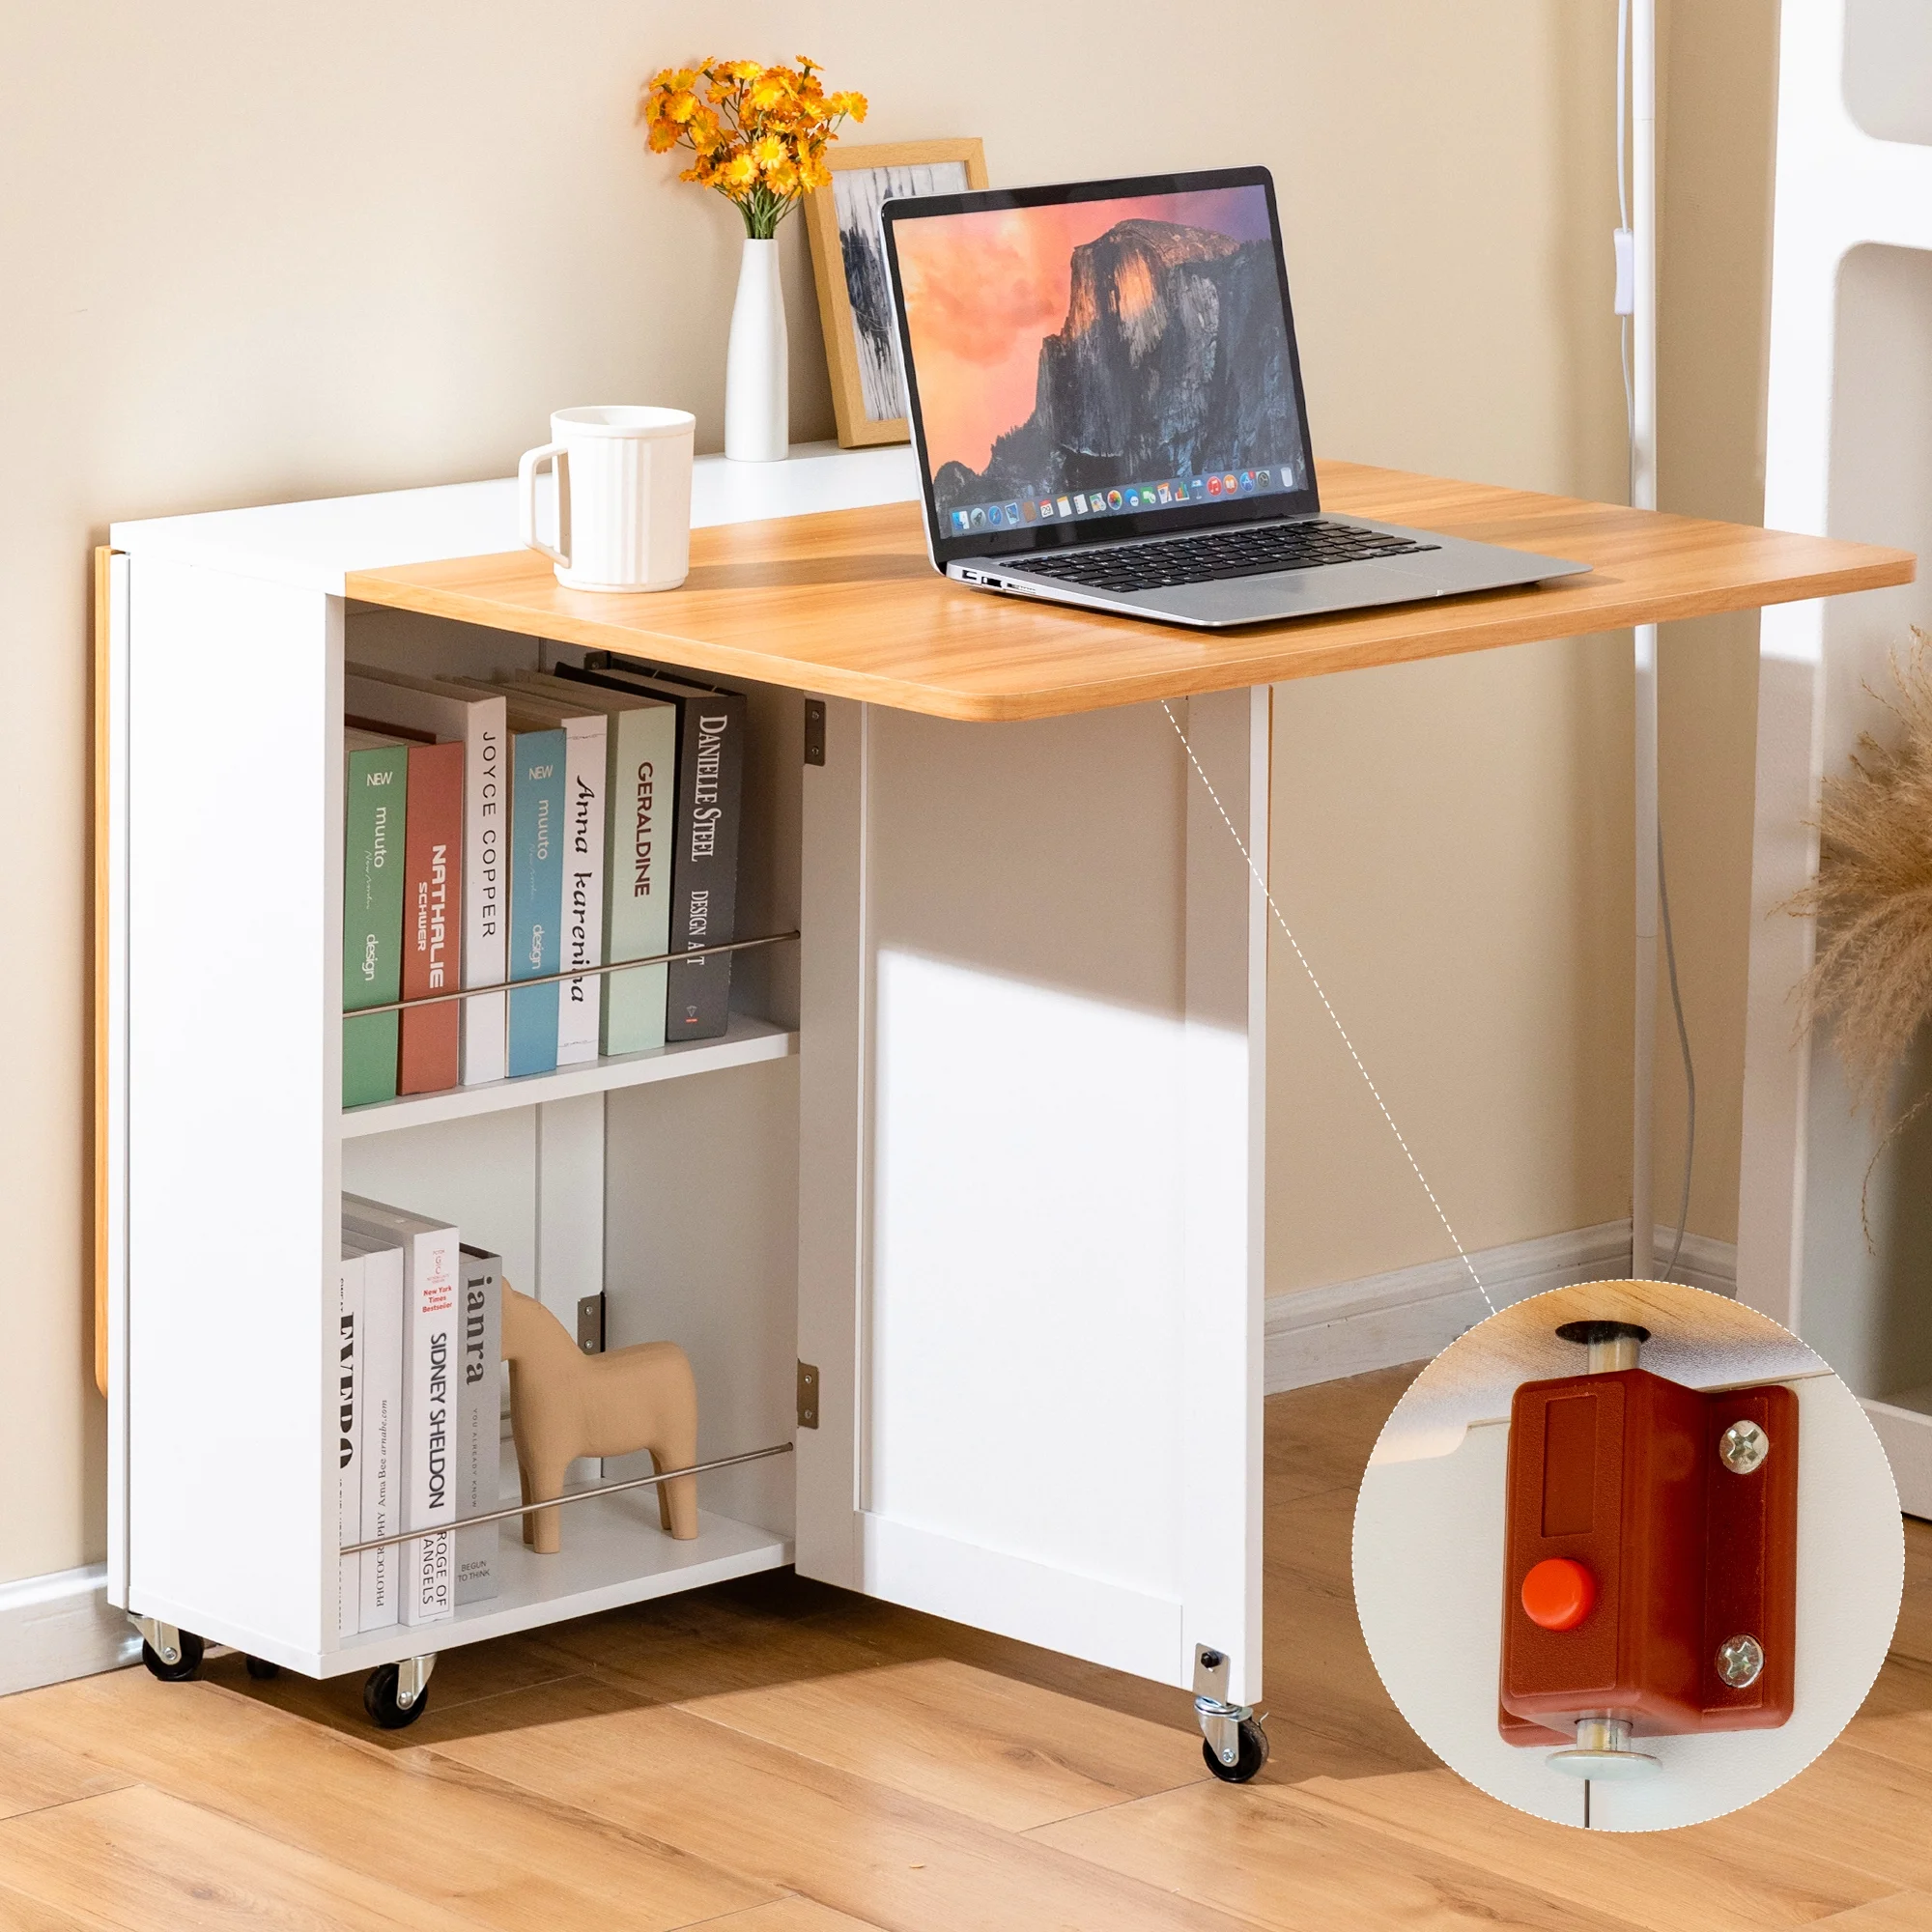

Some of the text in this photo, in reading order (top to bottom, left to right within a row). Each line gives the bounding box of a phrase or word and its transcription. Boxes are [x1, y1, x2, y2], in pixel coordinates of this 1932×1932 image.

[1042, 505, 1052, 516] 29
[366, 772, 393, 787] NEW
[529, 764, 554, 781] NEW
[692, 715, 727, 862] DANIELLE STEEL
[374, 807, 387, 867] muuto
[483, 731, 497, 937] JOYCE COPPER
[537, 799, 550, 860] muuto
[575, 775, 595, 854] Anna
[635, 761, 654, 897] GERALDINE
[417, 881, 428, 952] SCHWER
[430, 844, 447, 988] NATHALIE
[529, 923, 546, 970] design
[687, 890, 709, 966] DESIGN AT
[362, 933, 379, 981] design
[422, 1302, 453, 1313] Bestseller
[466, 1275, 493, 1385] ianra
[429, 1332, 447, 1509] SIDNEY SHELDON
[423, 1539, 434, 1605] ANGELS
[436, 1584, 447, 1605] OF
[458, 1569, 490, 1582] TO THINK
[461, 1560, 487, 1573] BEGUN
